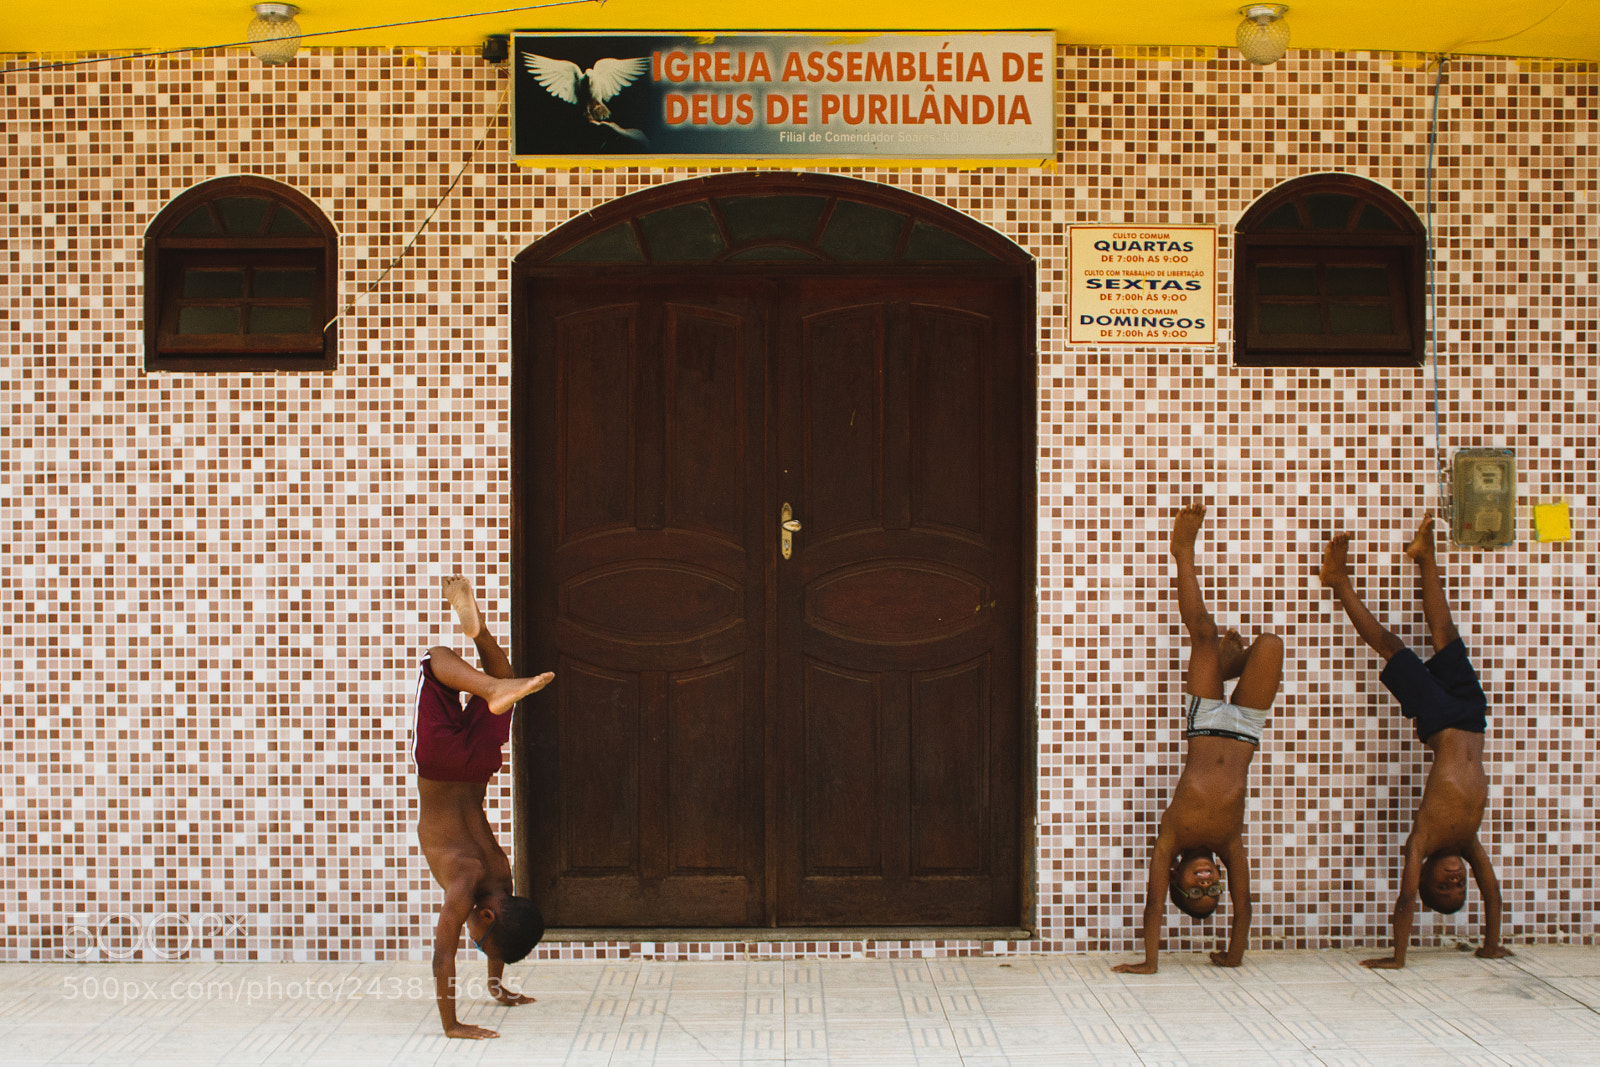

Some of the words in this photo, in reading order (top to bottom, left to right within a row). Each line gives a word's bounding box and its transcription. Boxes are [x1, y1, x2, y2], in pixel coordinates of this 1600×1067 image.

[653, 51, 772, 83] IGREJA
[782, 42, 991, 83] ASSEMBLÉIA
[1002, 52, 1044, 83] DE
[666, 93, 754, 125] DEUS
[766, 94, 808, 125] DE
[821, 84, 1032, 125] PURILÂNDIA
[779, 131, 806, 142] Filial
[808, 131, 822, 142] de
[825, 131, 895, 142] Comendador
[1094, 240, 1194, 252] QUARTAS
[1117, 255, 1145, 263] 7:00h
[1167, 269, 1204, 278] LIBERTAÇÃO
[1086, 278, 1202, 291] SEXTAS
[1100, 293, 1112, 301] DE
[1116, 293, 1143, 301] 7:00h
[1080, 315, 1206, 329] DOMINGOS
